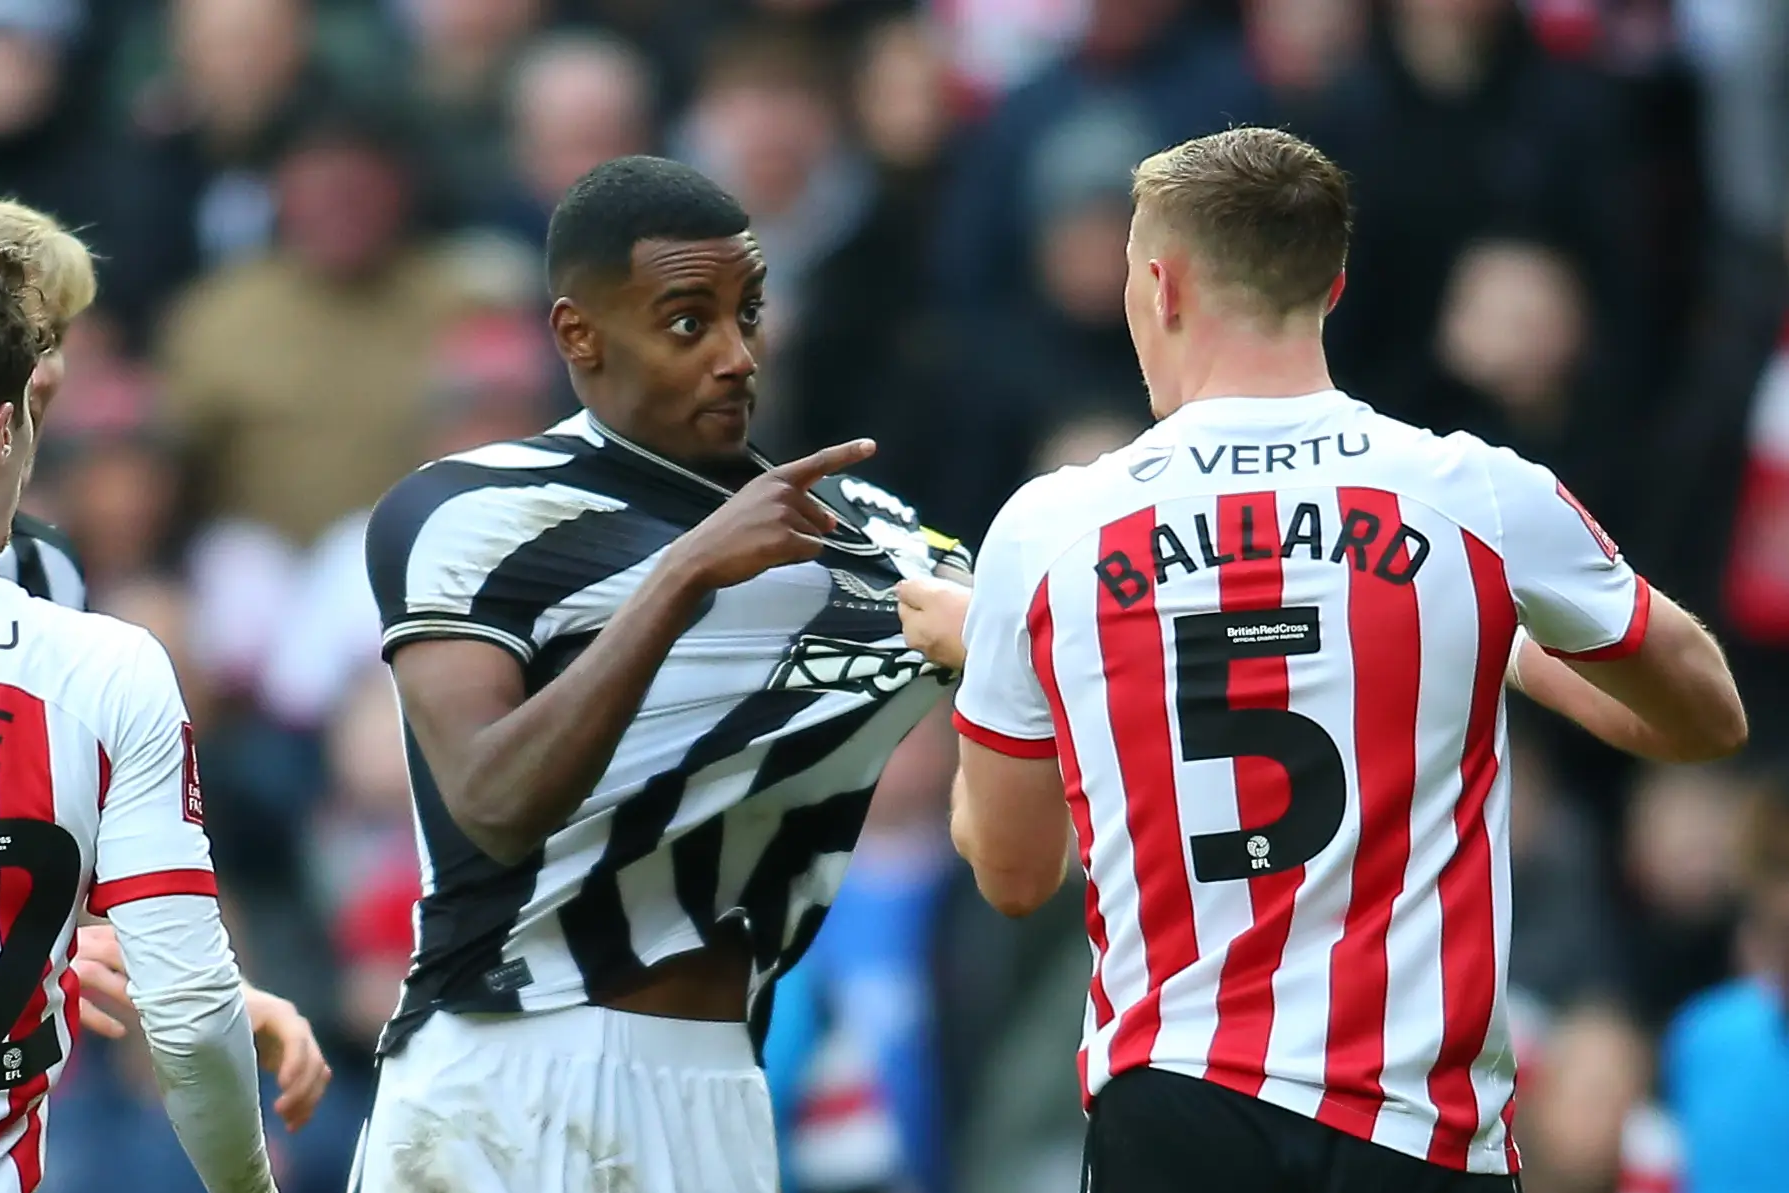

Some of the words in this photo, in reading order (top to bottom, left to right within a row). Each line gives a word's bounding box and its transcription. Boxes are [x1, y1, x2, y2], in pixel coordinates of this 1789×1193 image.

[1189, 432, 1371, 475] VERTU
[1094, 502, 1431, 609] BALLARD
[1226, 623, 1310, 638] BritishRedCross
[1172, 606, 1347, 884] 5
[1250, 857, 1271, 870] EFL
[5, 1069, 22, 1081] EFL
